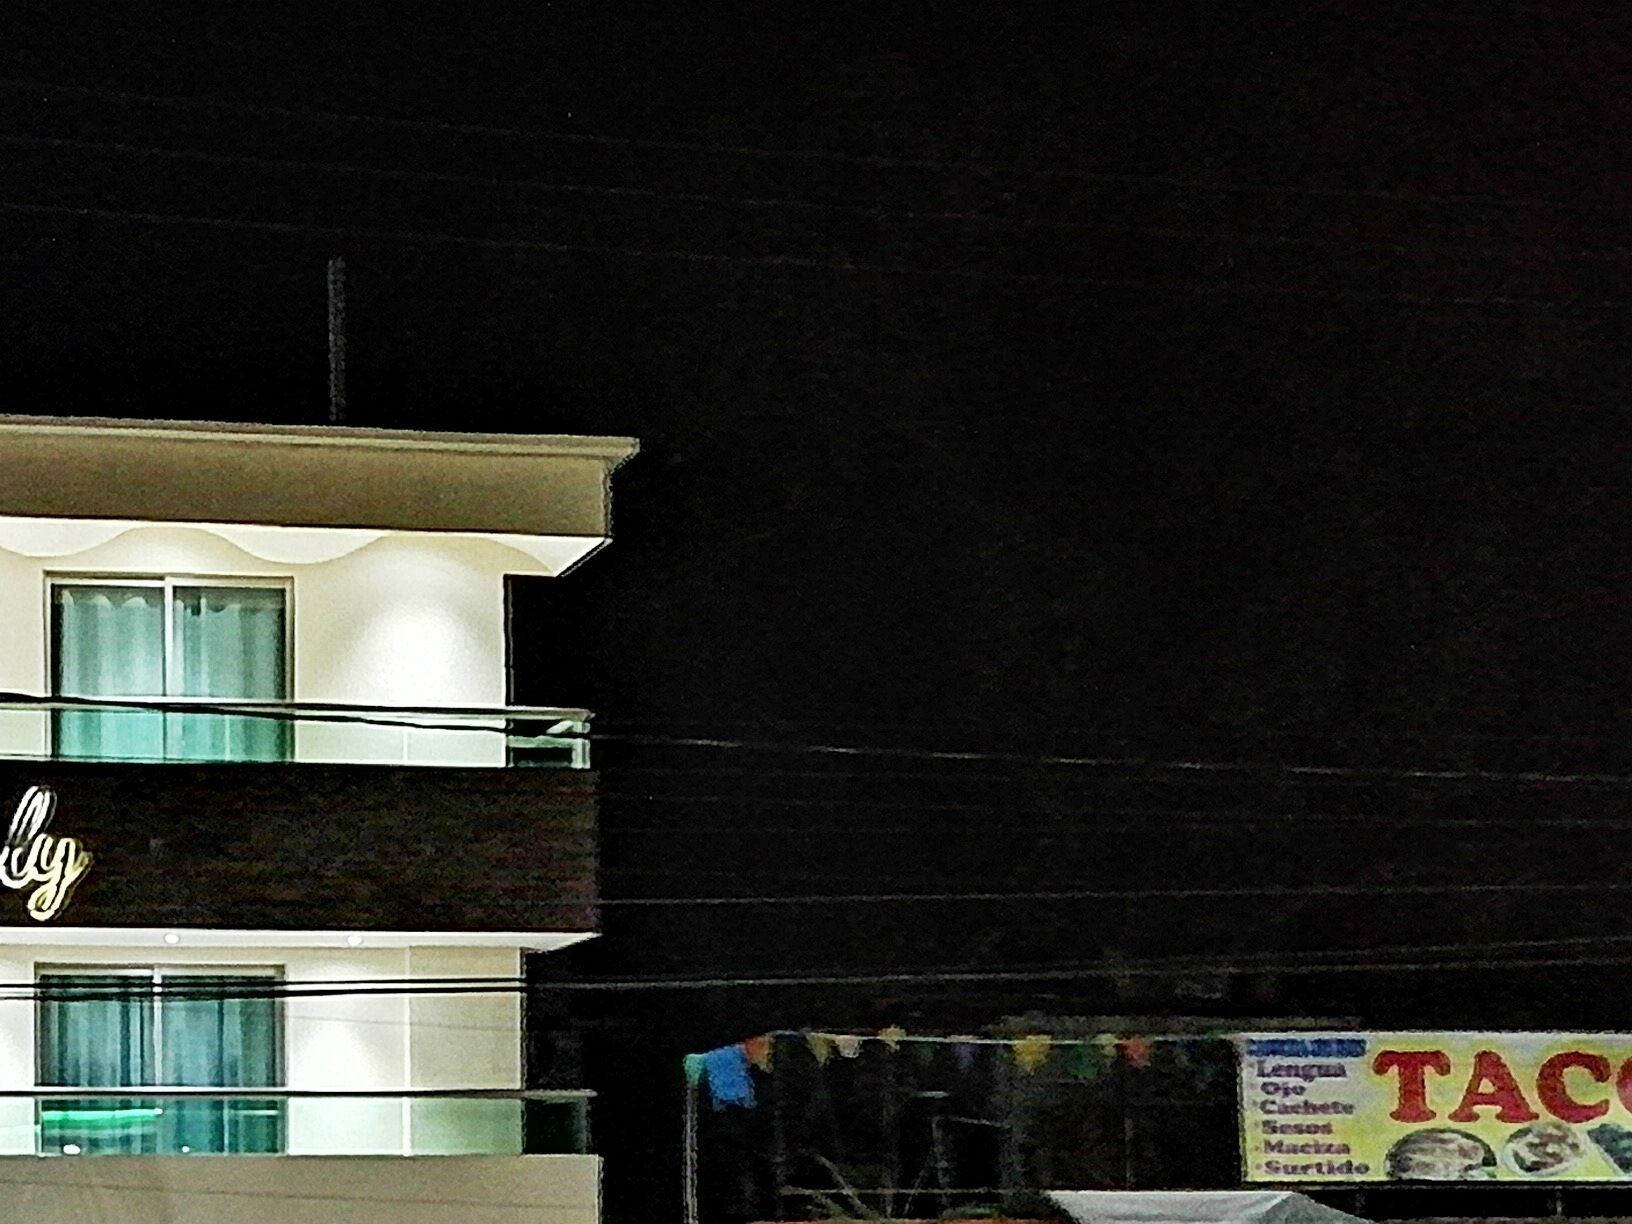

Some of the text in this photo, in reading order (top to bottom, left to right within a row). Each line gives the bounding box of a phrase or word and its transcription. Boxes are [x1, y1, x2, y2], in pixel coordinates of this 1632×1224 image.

[1256, 1060, 1347, 1082] Lengua
[1260, 1082, 1306, 1097] Ojo
[1264, 1159, 1370, 1176] Surtido
